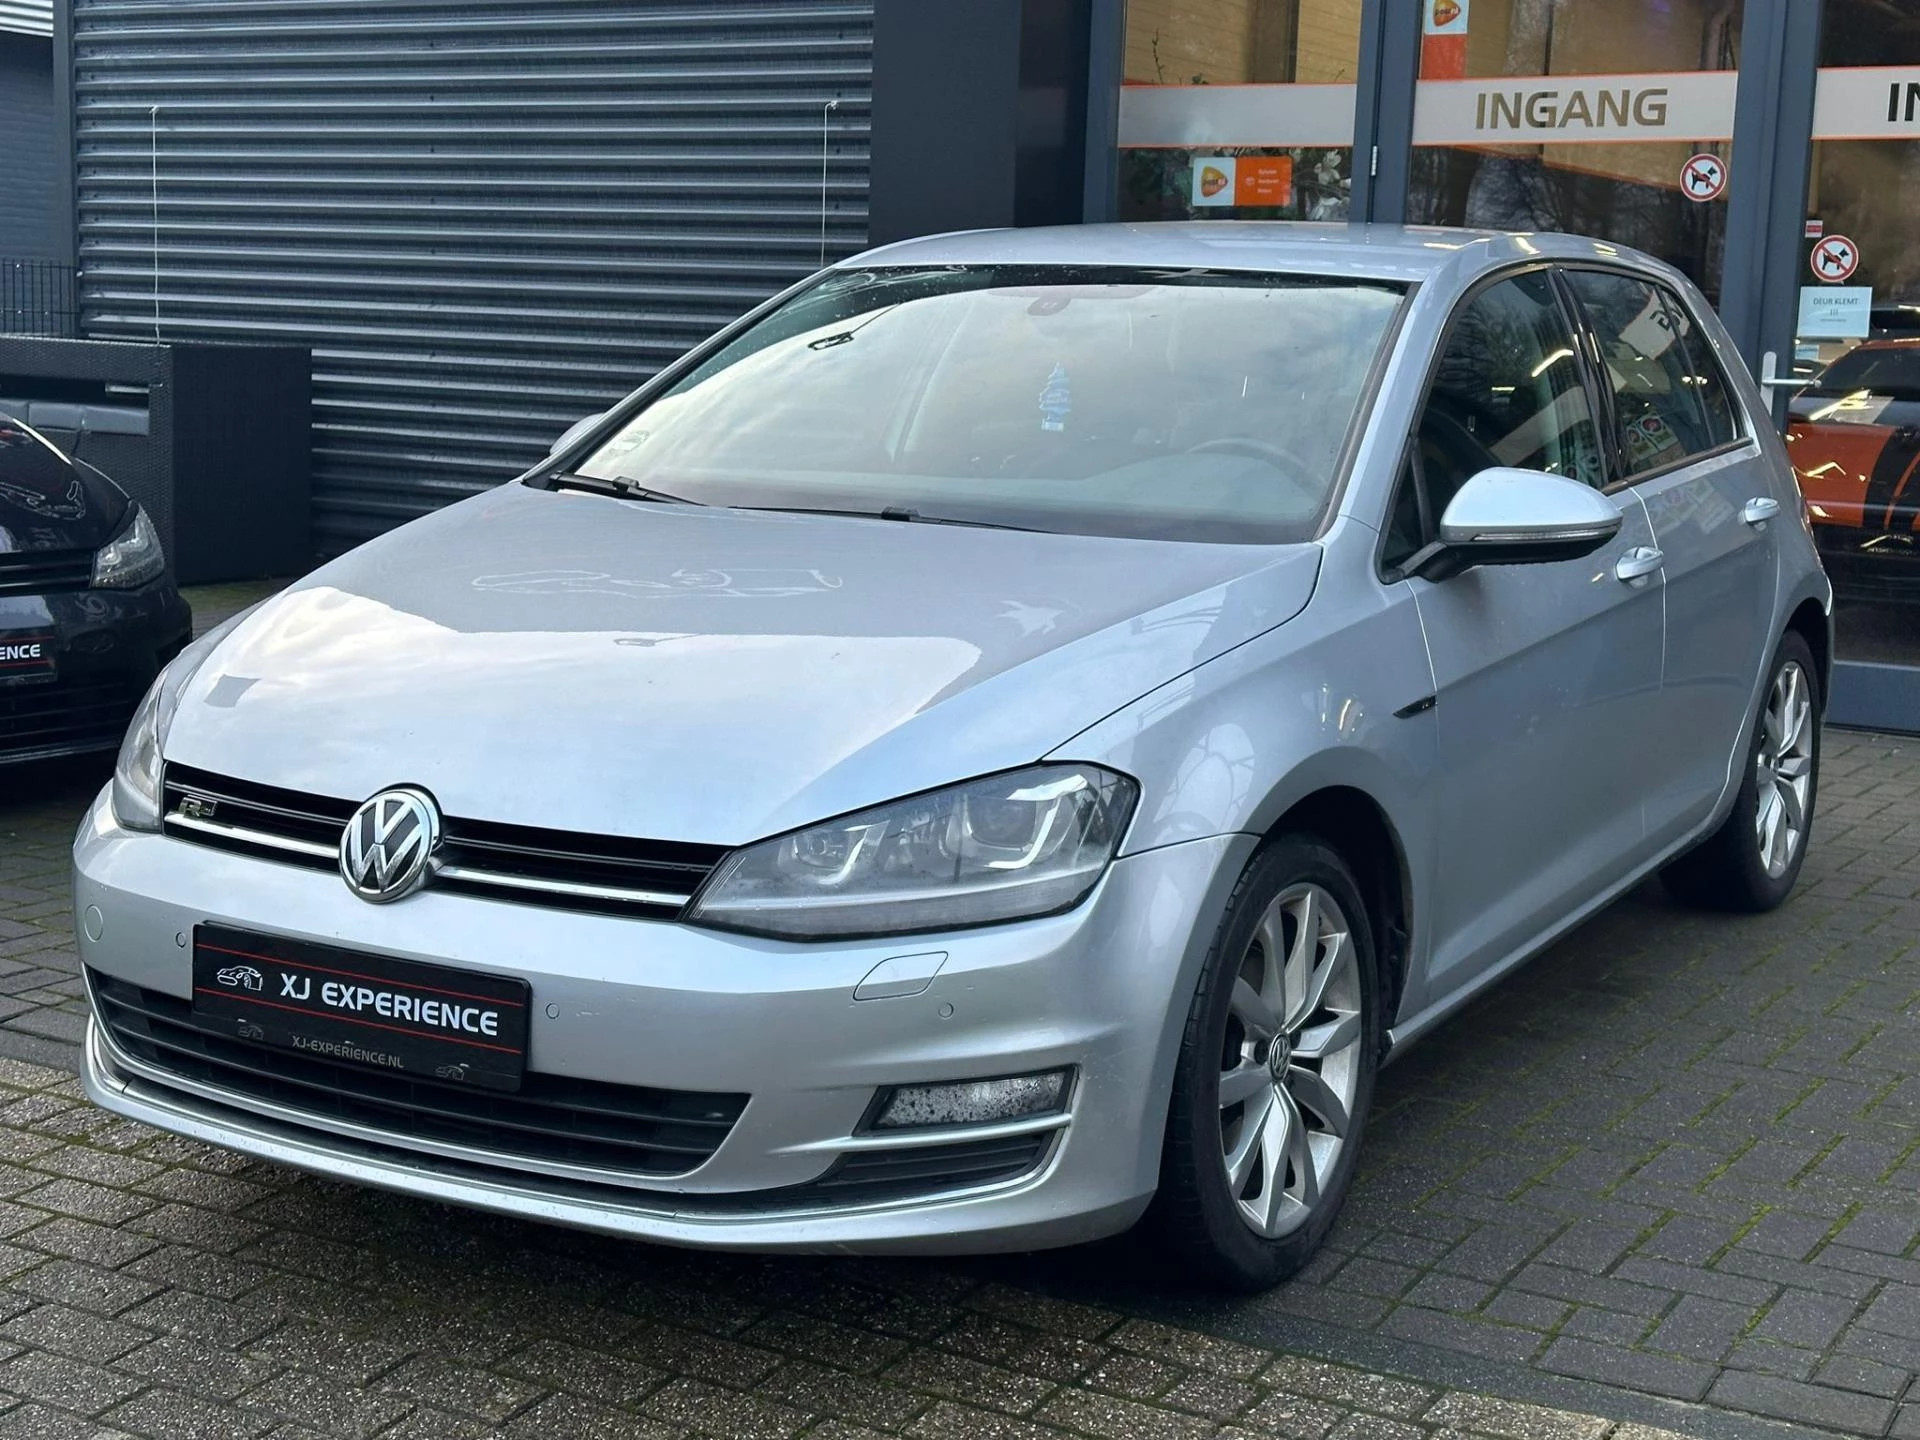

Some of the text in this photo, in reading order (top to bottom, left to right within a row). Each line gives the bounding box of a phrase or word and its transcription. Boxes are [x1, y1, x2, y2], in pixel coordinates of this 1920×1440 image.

[1476, 88, 1668, 129] INGANG
[1813, 297, 1859, 305] DEUR KLEMT
[280, 972, 498, 1036] XJ EXPERIENCE
[291, 1035, 404, 1069] XJ-EXPERIENCE.NL
